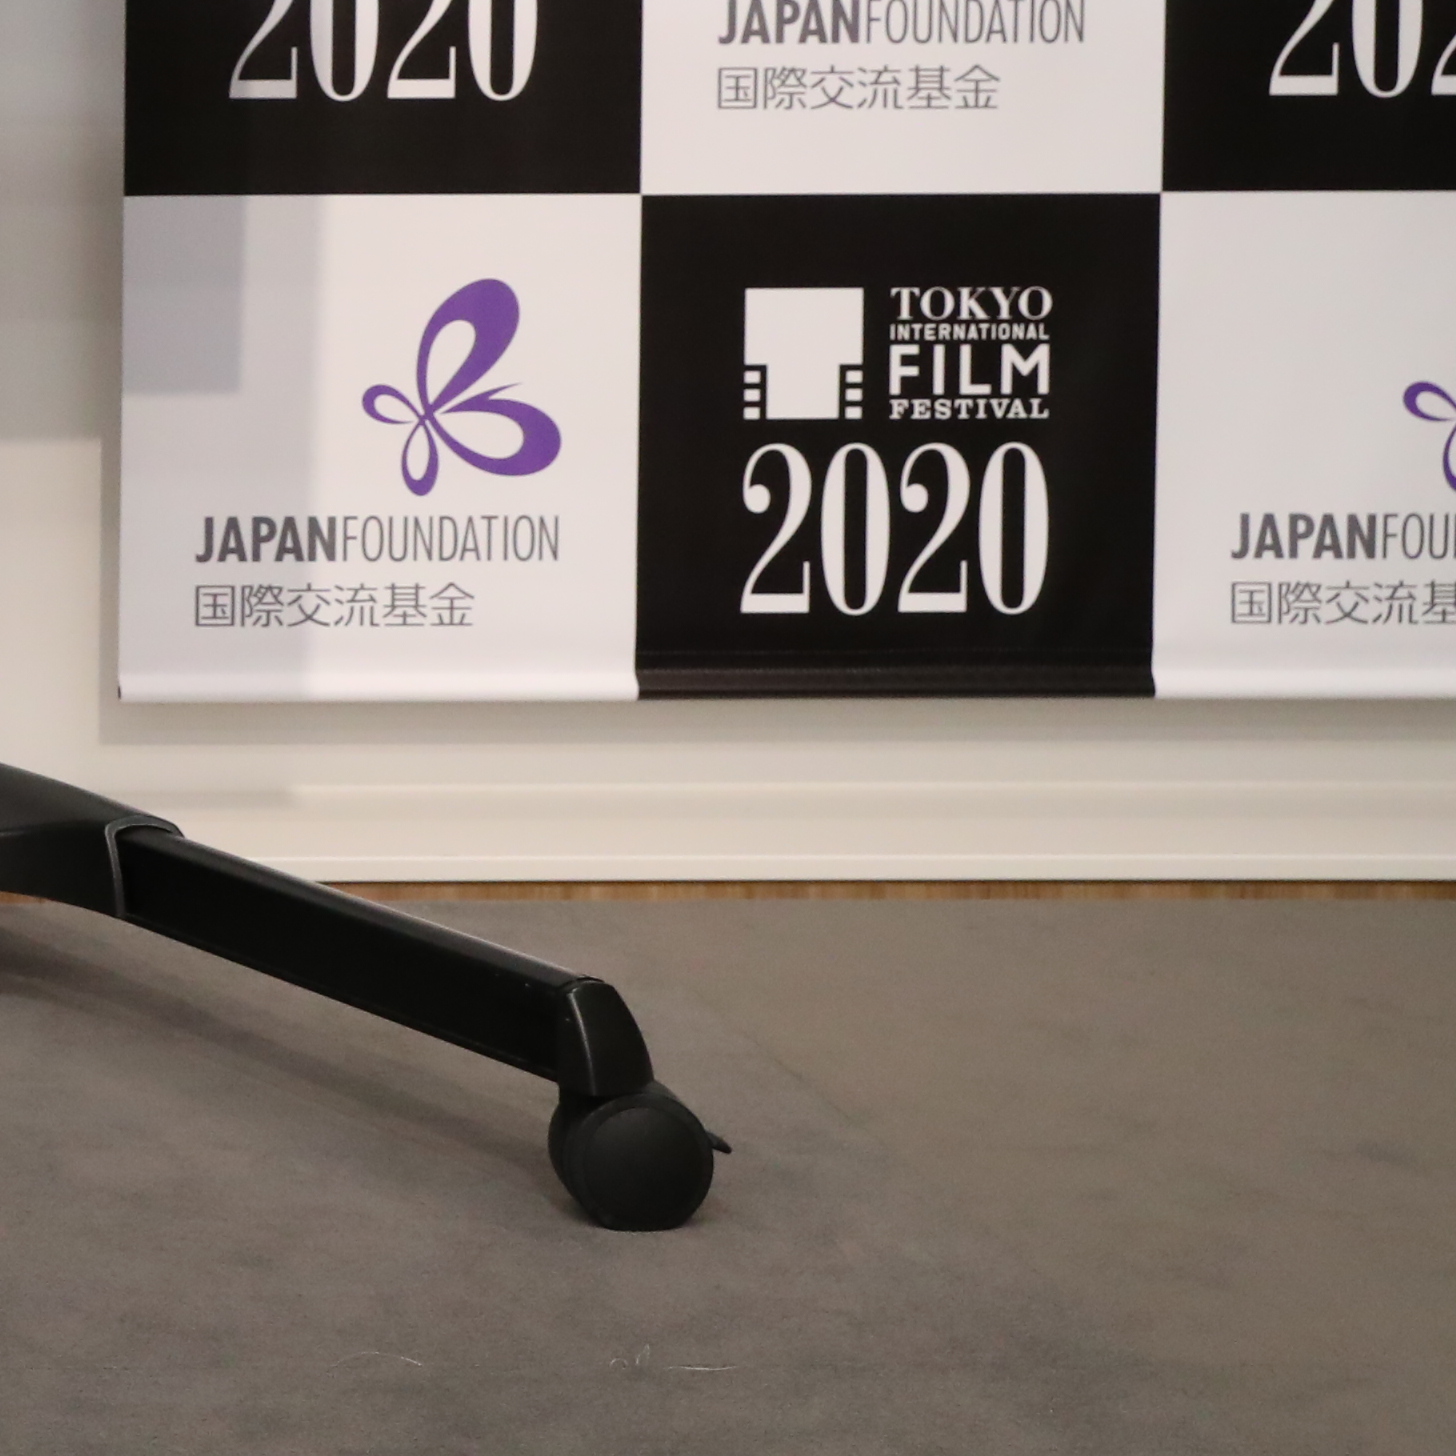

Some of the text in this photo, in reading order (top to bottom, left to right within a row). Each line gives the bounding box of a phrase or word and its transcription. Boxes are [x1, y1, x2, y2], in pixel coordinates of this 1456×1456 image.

[716, 63, 1002, 111] 国際交流基金
[890, 286, 1054, 321] TOKYO
[889, 322, 1050, 341] INTERNATIONAL
[889, 343, 1050, 396] FILM
[889, 398, 1050, 420] FESTIVAL
[194, 515, 560, 564] JAPANFOUNDATION
[739, 441, 1050, 617] 2020
[1230, 512, 1456, 561] JAPANFOU
[193, 582, 476, 630] 国際交流基金
